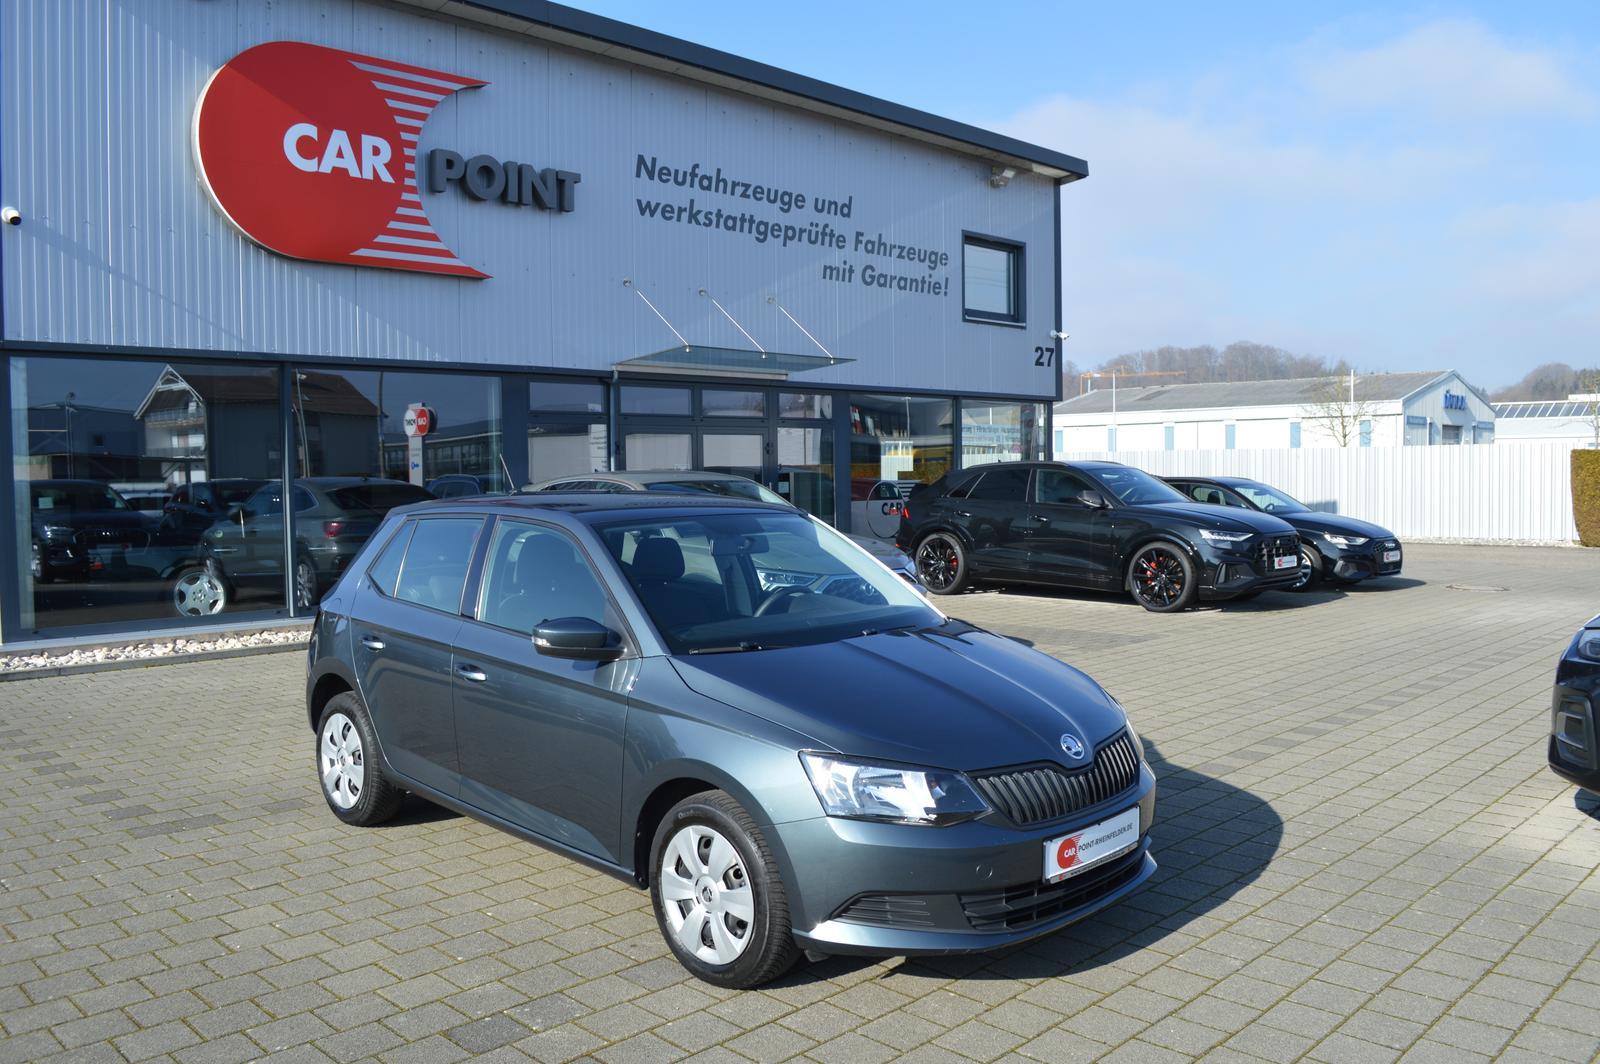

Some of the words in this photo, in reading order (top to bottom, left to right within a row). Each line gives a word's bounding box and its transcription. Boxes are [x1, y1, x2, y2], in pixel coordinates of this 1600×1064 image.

[283, 122, 396, 184] CAR
[430, 147, 581, 213] POINT
[635, 154, 806, 214] Neufahrzeuge
[814, 195, 853, 218] und
[635, 198, 847, 247] werkstattgeprüfte
[853, 231, 949, 270] Fahrzeuge
[822, 260, 855, 283] mit
[861, 264, 949, 296] Garantie!
[1034, 346, 1056, 367] 27
[1064, 847, 1076, 858] CAR
[1078, 822, 1134, 853] POINT-RHEINFELDEN.DE
